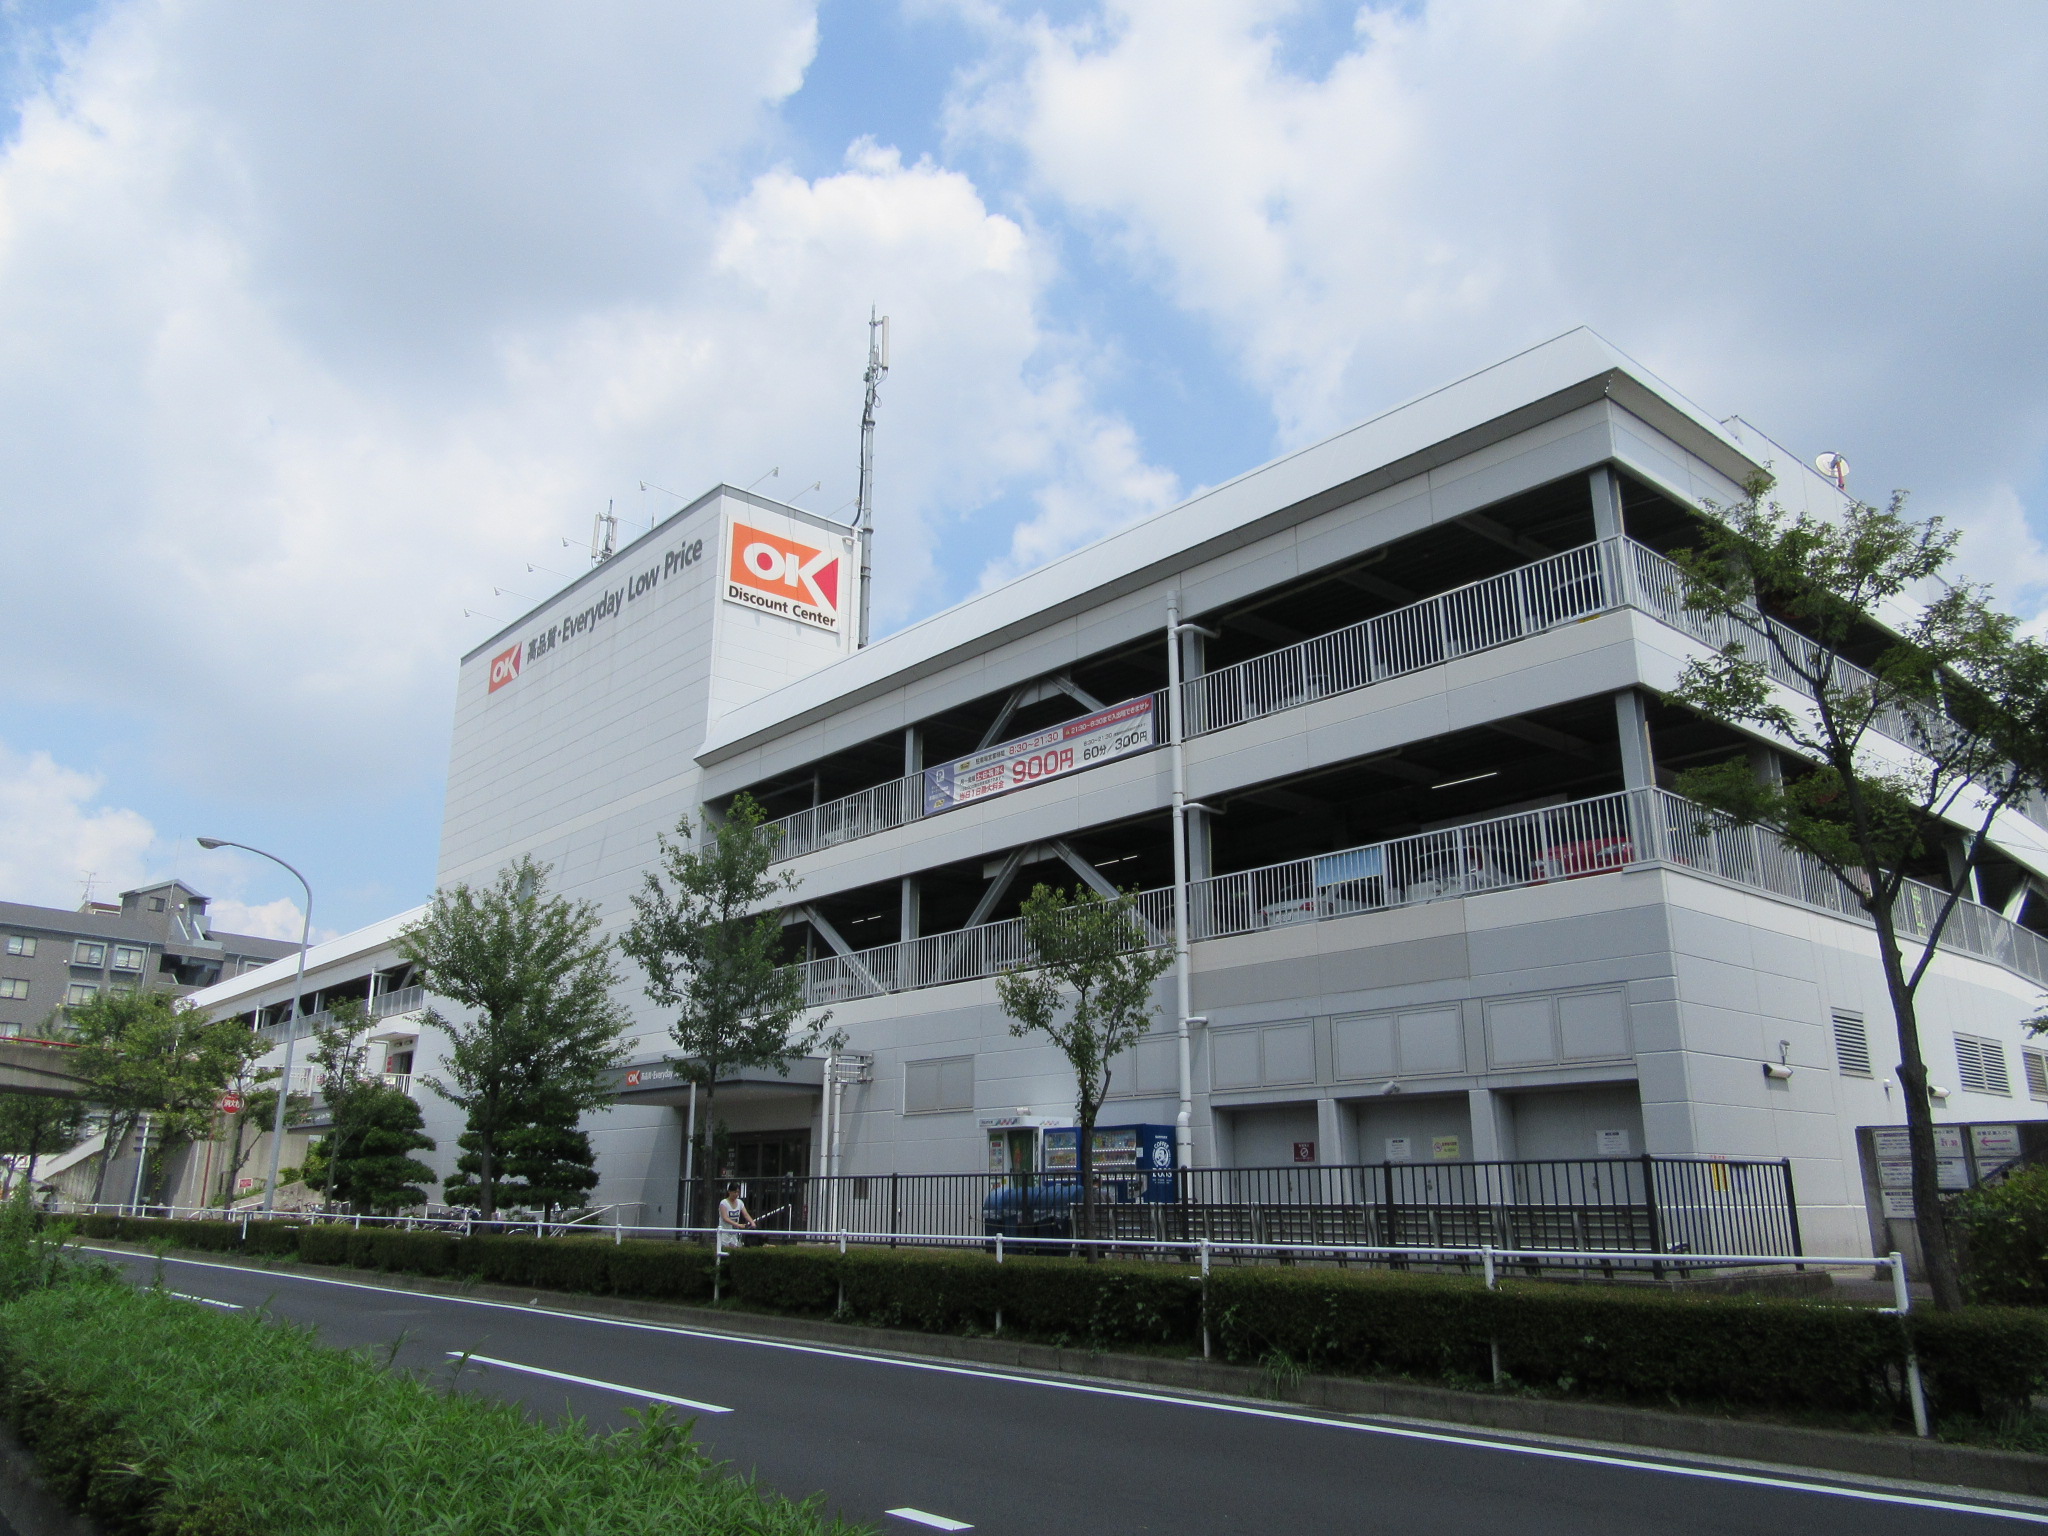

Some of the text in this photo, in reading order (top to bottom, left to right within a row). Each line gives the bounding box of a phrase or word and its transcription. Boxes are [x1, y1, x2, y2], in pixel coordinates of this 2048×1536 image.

[627, 564, 660, 602] Low
[663, 537, 704, 580] Price
[742, 542, 839, 611] OK
[728, 584, 836, 628] Discount Center
[492, 643, 521, 684] OK
[1012, 747, 1074, 784] 900円
